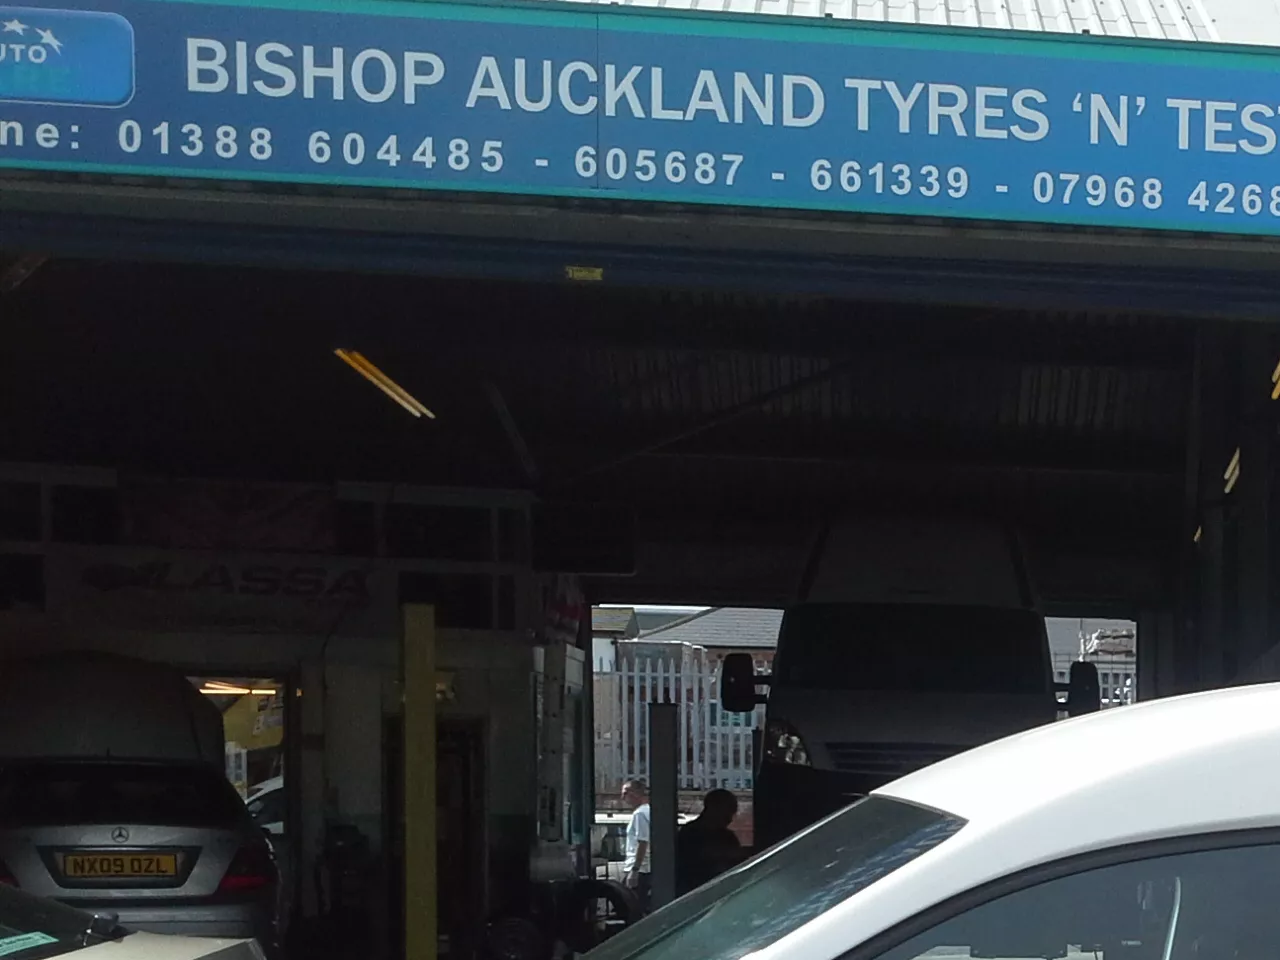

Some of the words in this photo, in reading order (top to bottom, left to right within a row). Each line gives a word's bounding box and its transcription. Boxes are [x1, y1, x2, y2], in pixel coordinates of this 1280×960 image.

[187, 38, 444, 104] BISHOP
[466, 57, 824, 126] AUCKLAND
[845, 79, 1049, 141] TYRES
[119, 120, 271, 160] 01388
[309, 131, 503, 172] 604485
[576, 146, 743, 185] 605687
[811, 160, 967, 198] 661339
[1034, 172, 1162, 209] 07968
[155, 562, 371, 597] LASSA
[72, 857, 125, 876] NX09
